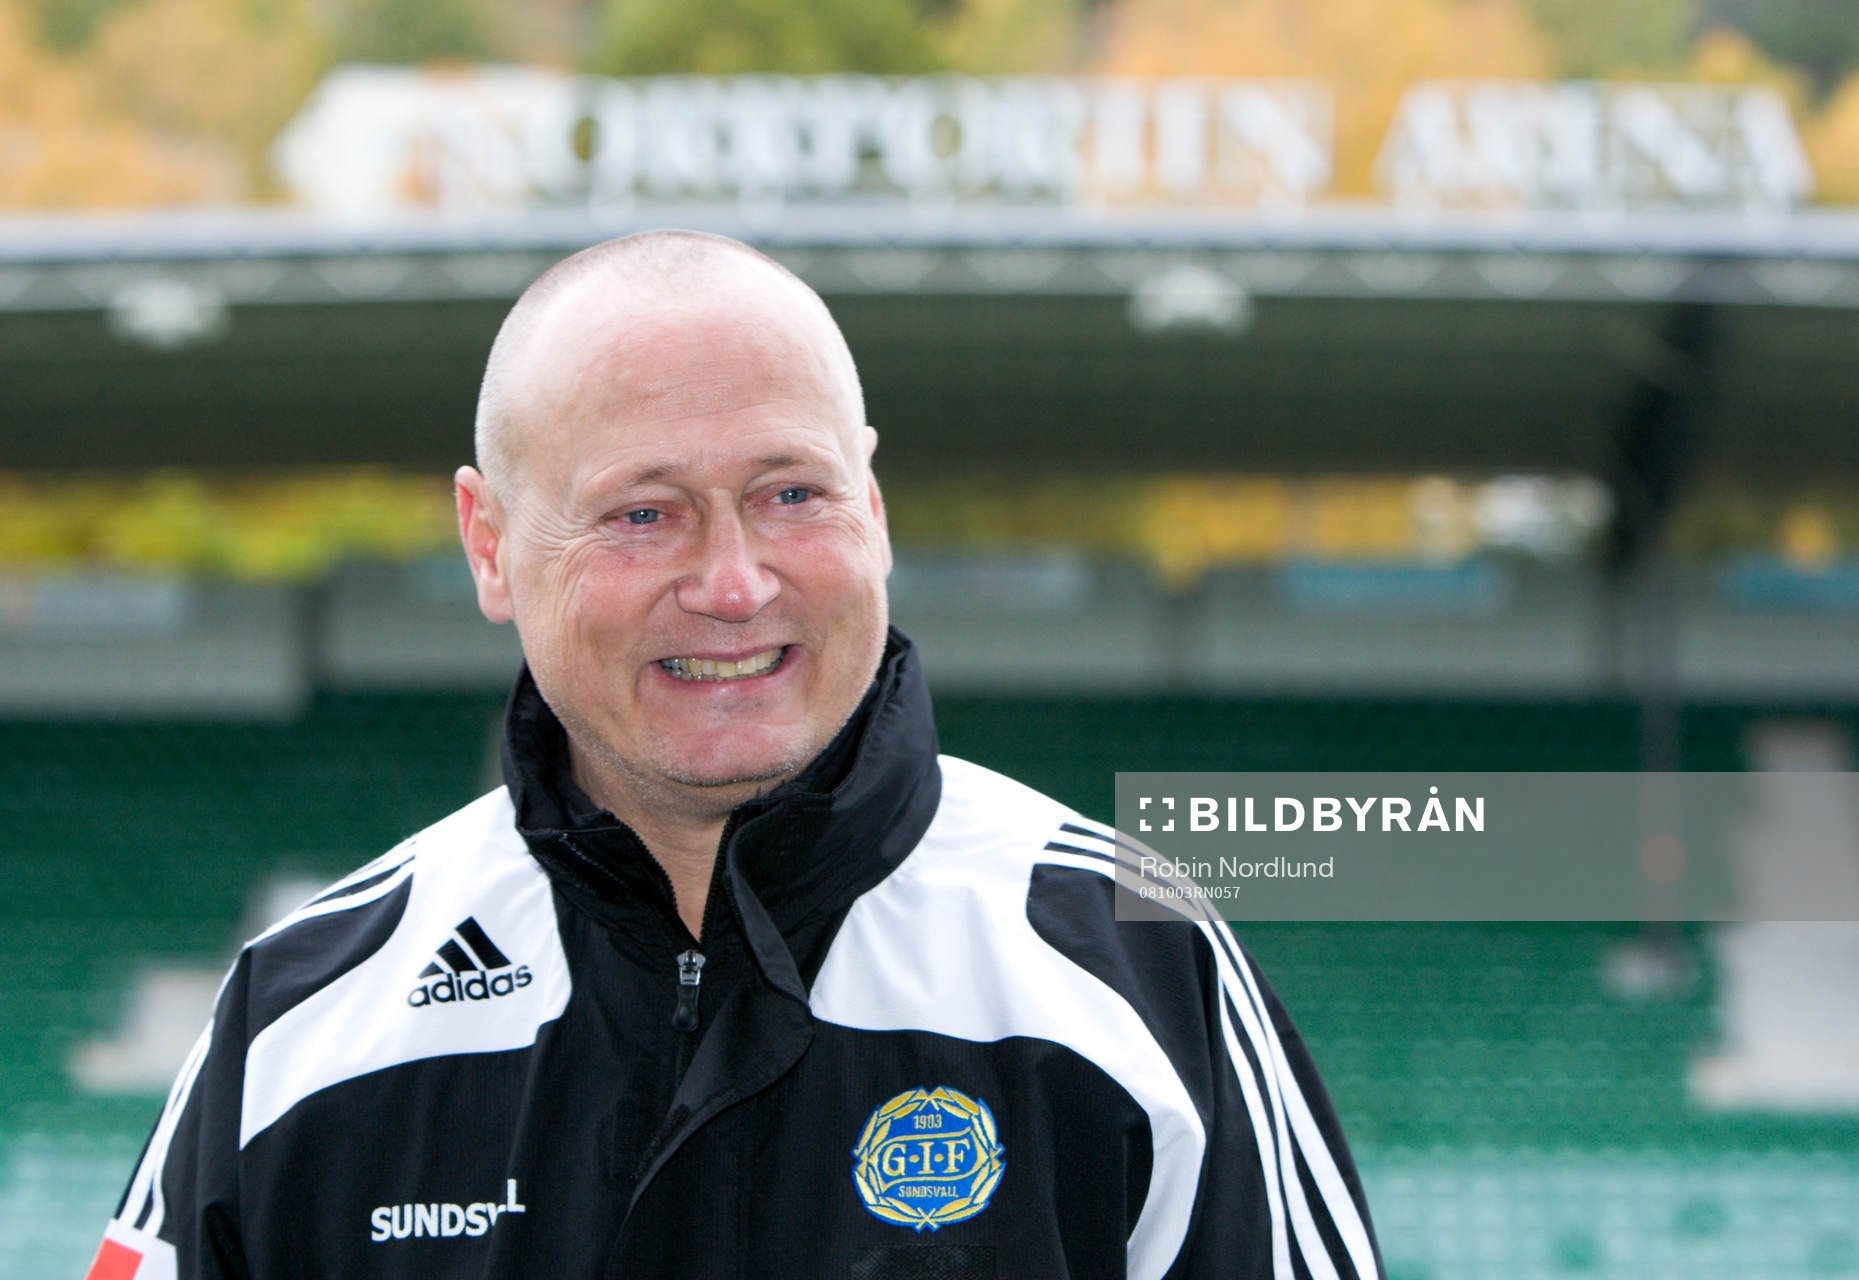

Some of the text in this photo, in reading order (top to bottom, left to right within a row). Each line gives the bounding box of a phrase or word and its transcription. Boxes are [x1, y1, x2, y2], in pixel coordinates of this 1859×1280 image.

[407, 965, 532, 1008] adidas
[913, 1113, 943, 1130] 1903
[897, 1184, 960, 1199] SUNDSVALL
[371, 1178, 526, 1242] SUNDSVL
